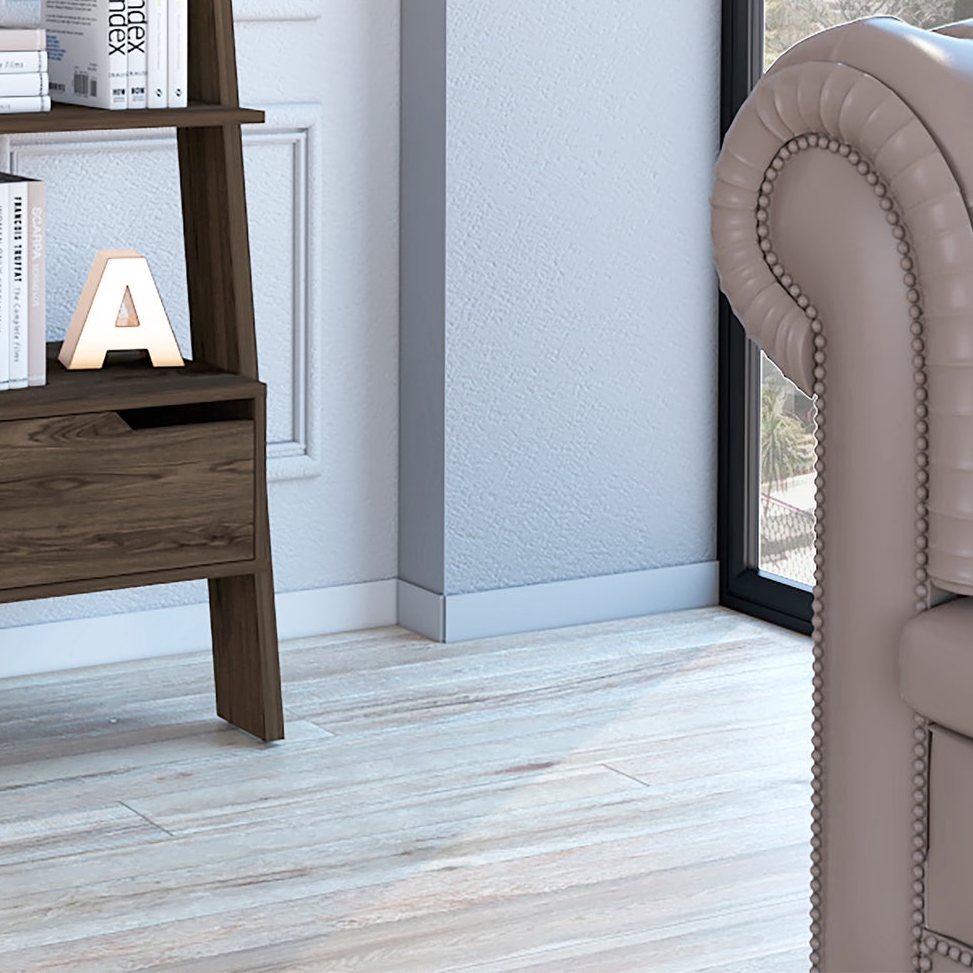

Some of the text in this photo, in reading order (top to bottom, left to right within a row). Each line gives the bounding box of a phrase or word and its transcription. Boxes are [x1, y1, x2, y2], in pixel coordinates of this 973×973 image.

[4, 60, 24, 69] Films
[31, 206, 43, 261] SCARPA
[13, 287, 21, 300] The
[12, 303, 21, 339] Complete
[58, 249, 186, 371] A
[13, 341, 21, 363] Films
